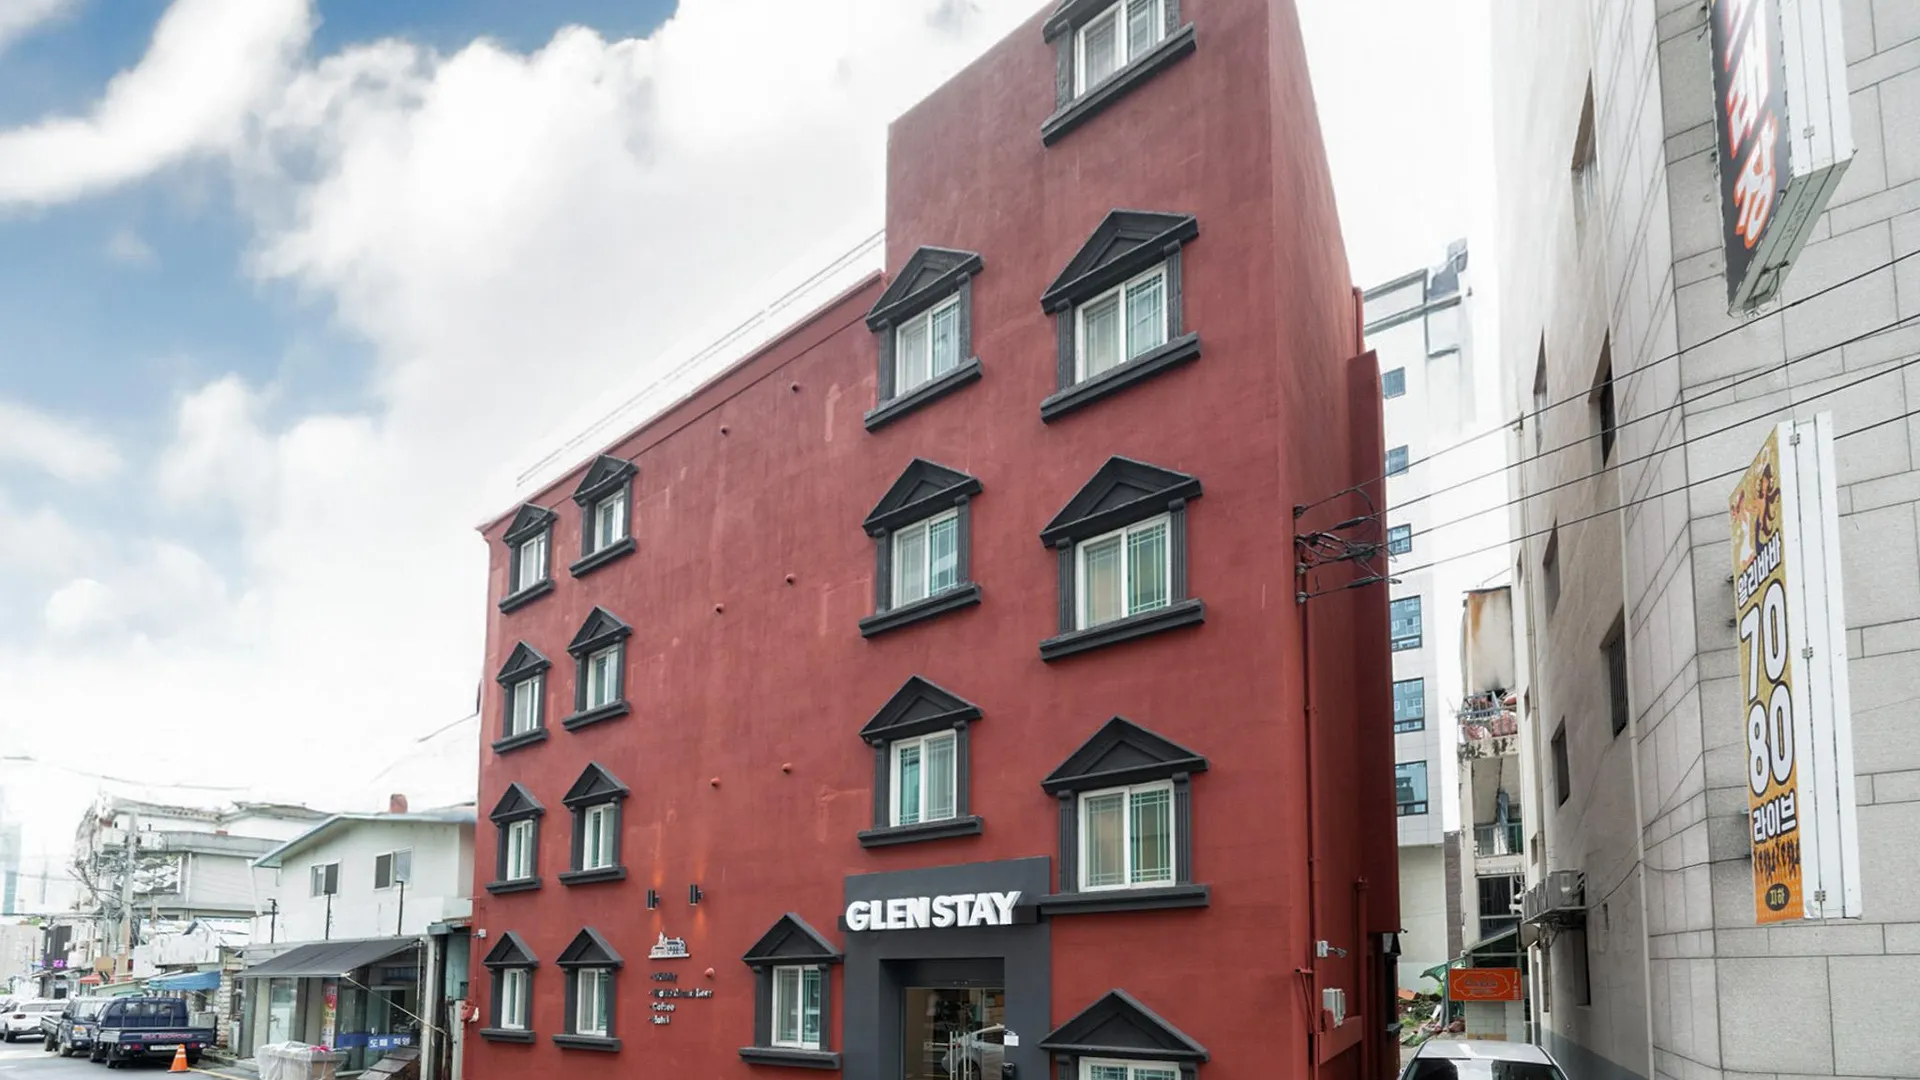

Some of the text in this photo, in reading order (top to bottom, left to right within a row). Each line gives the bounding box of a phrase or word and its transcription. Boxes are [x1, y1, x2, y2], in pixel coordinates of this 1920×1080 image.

[1738, 529, 1781, 610] 알리바바
[1740, 578, 1788, 703] 70
[1748, 681, 1795, 797] 80
[1752, 788, 1797, 844] 라이브
